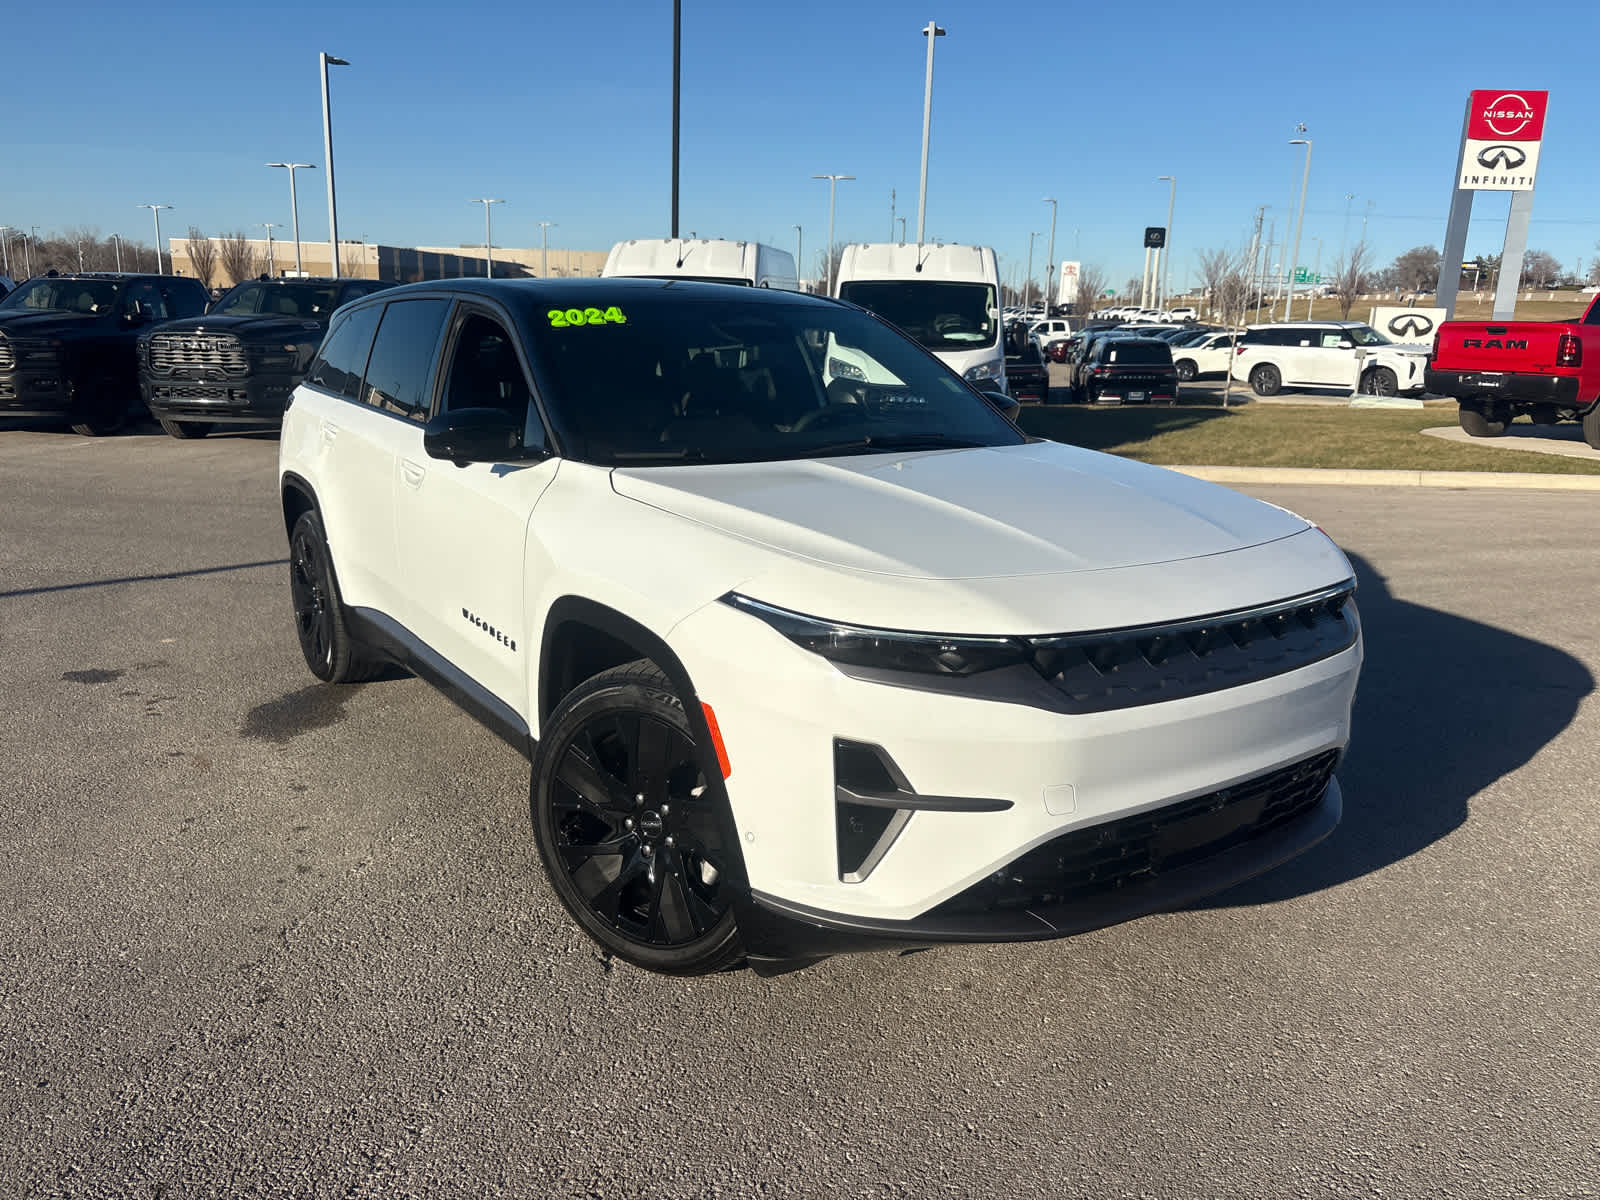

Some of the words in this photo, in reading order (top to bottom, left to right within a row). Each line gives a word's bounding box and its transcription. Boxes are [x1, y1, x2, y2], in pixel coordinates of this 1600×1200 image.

[1483, 110, 1534, 119] NISSAN
[1463, 175, 1533, 185] INFINITI
[547, 306, 627, 327] 2024
[1463, 338, 1528, 350] RAM
[461, 607, 517, 652] WAGONEER
